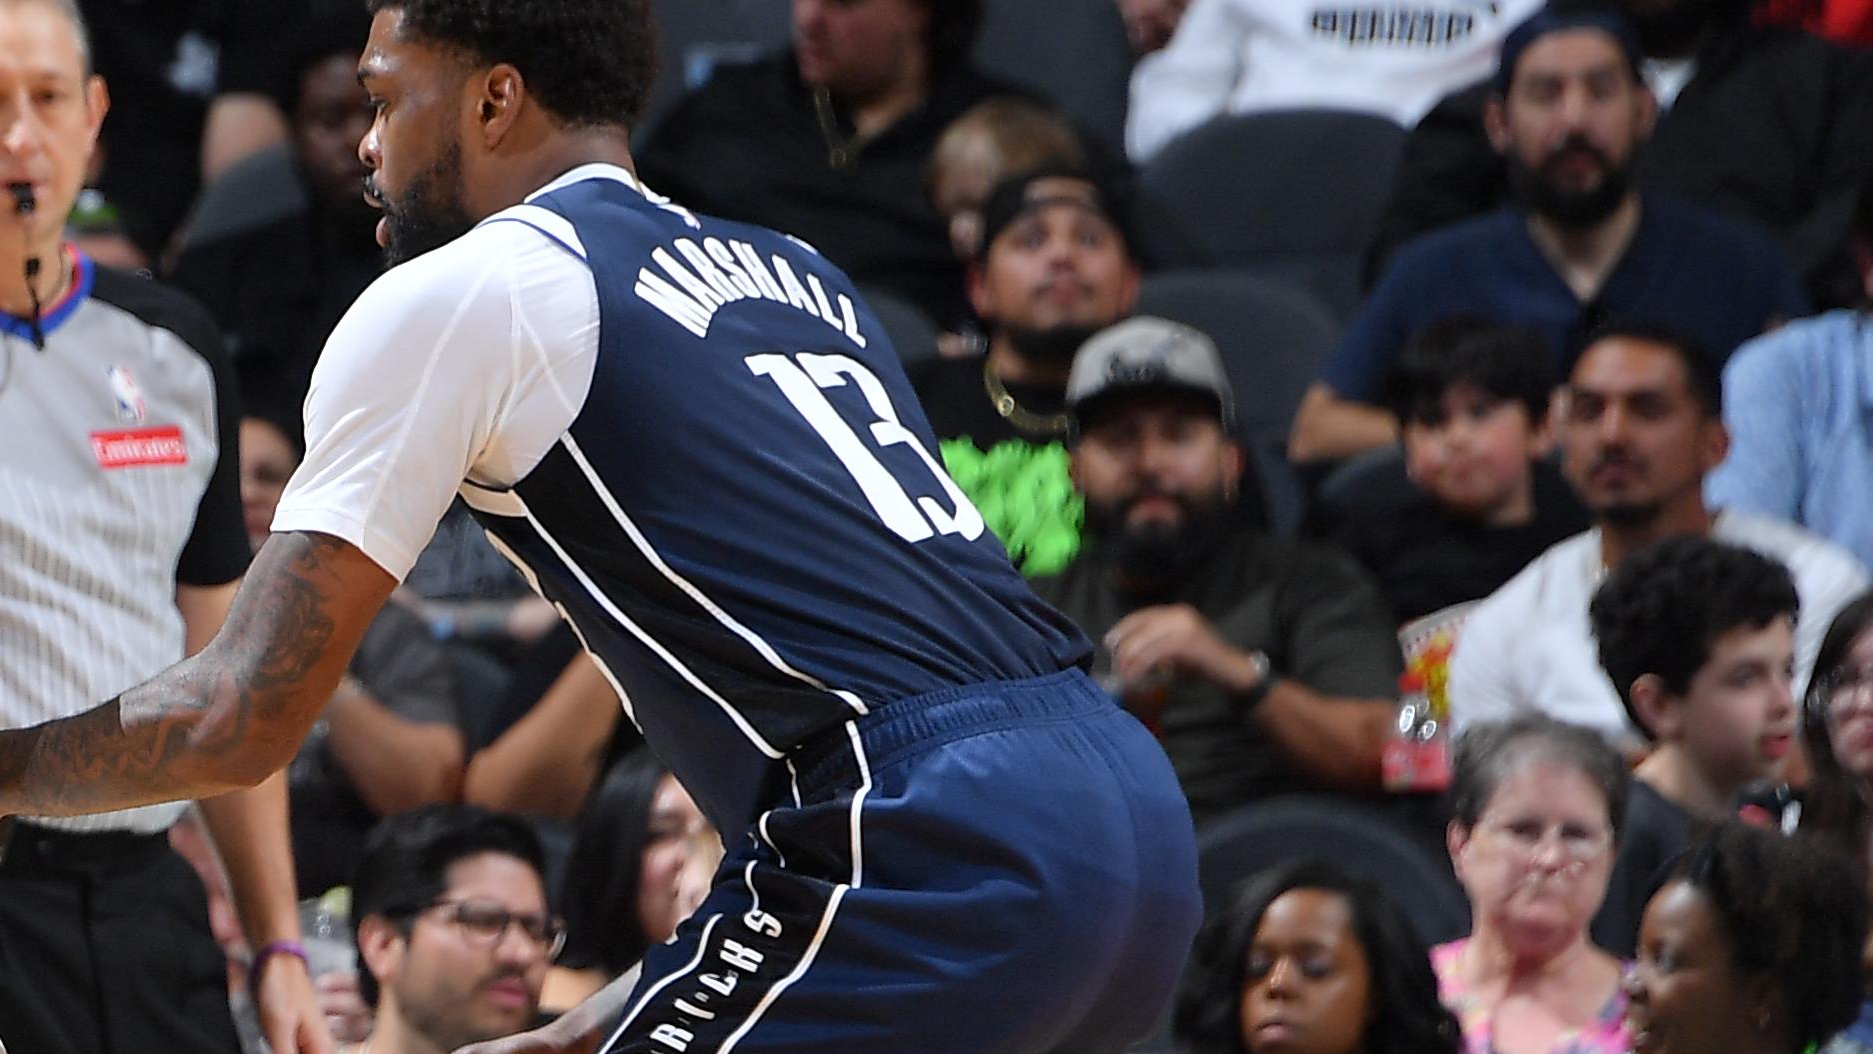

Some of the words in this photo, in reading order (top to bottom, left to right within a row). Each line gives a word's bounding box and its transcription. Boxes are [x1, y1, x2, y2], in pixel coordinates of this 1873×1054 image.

[634, 236, 867, 349] MARSHALL
[93, 437, 187, 462] Emirates
[743, 352, 985, 543] 13
